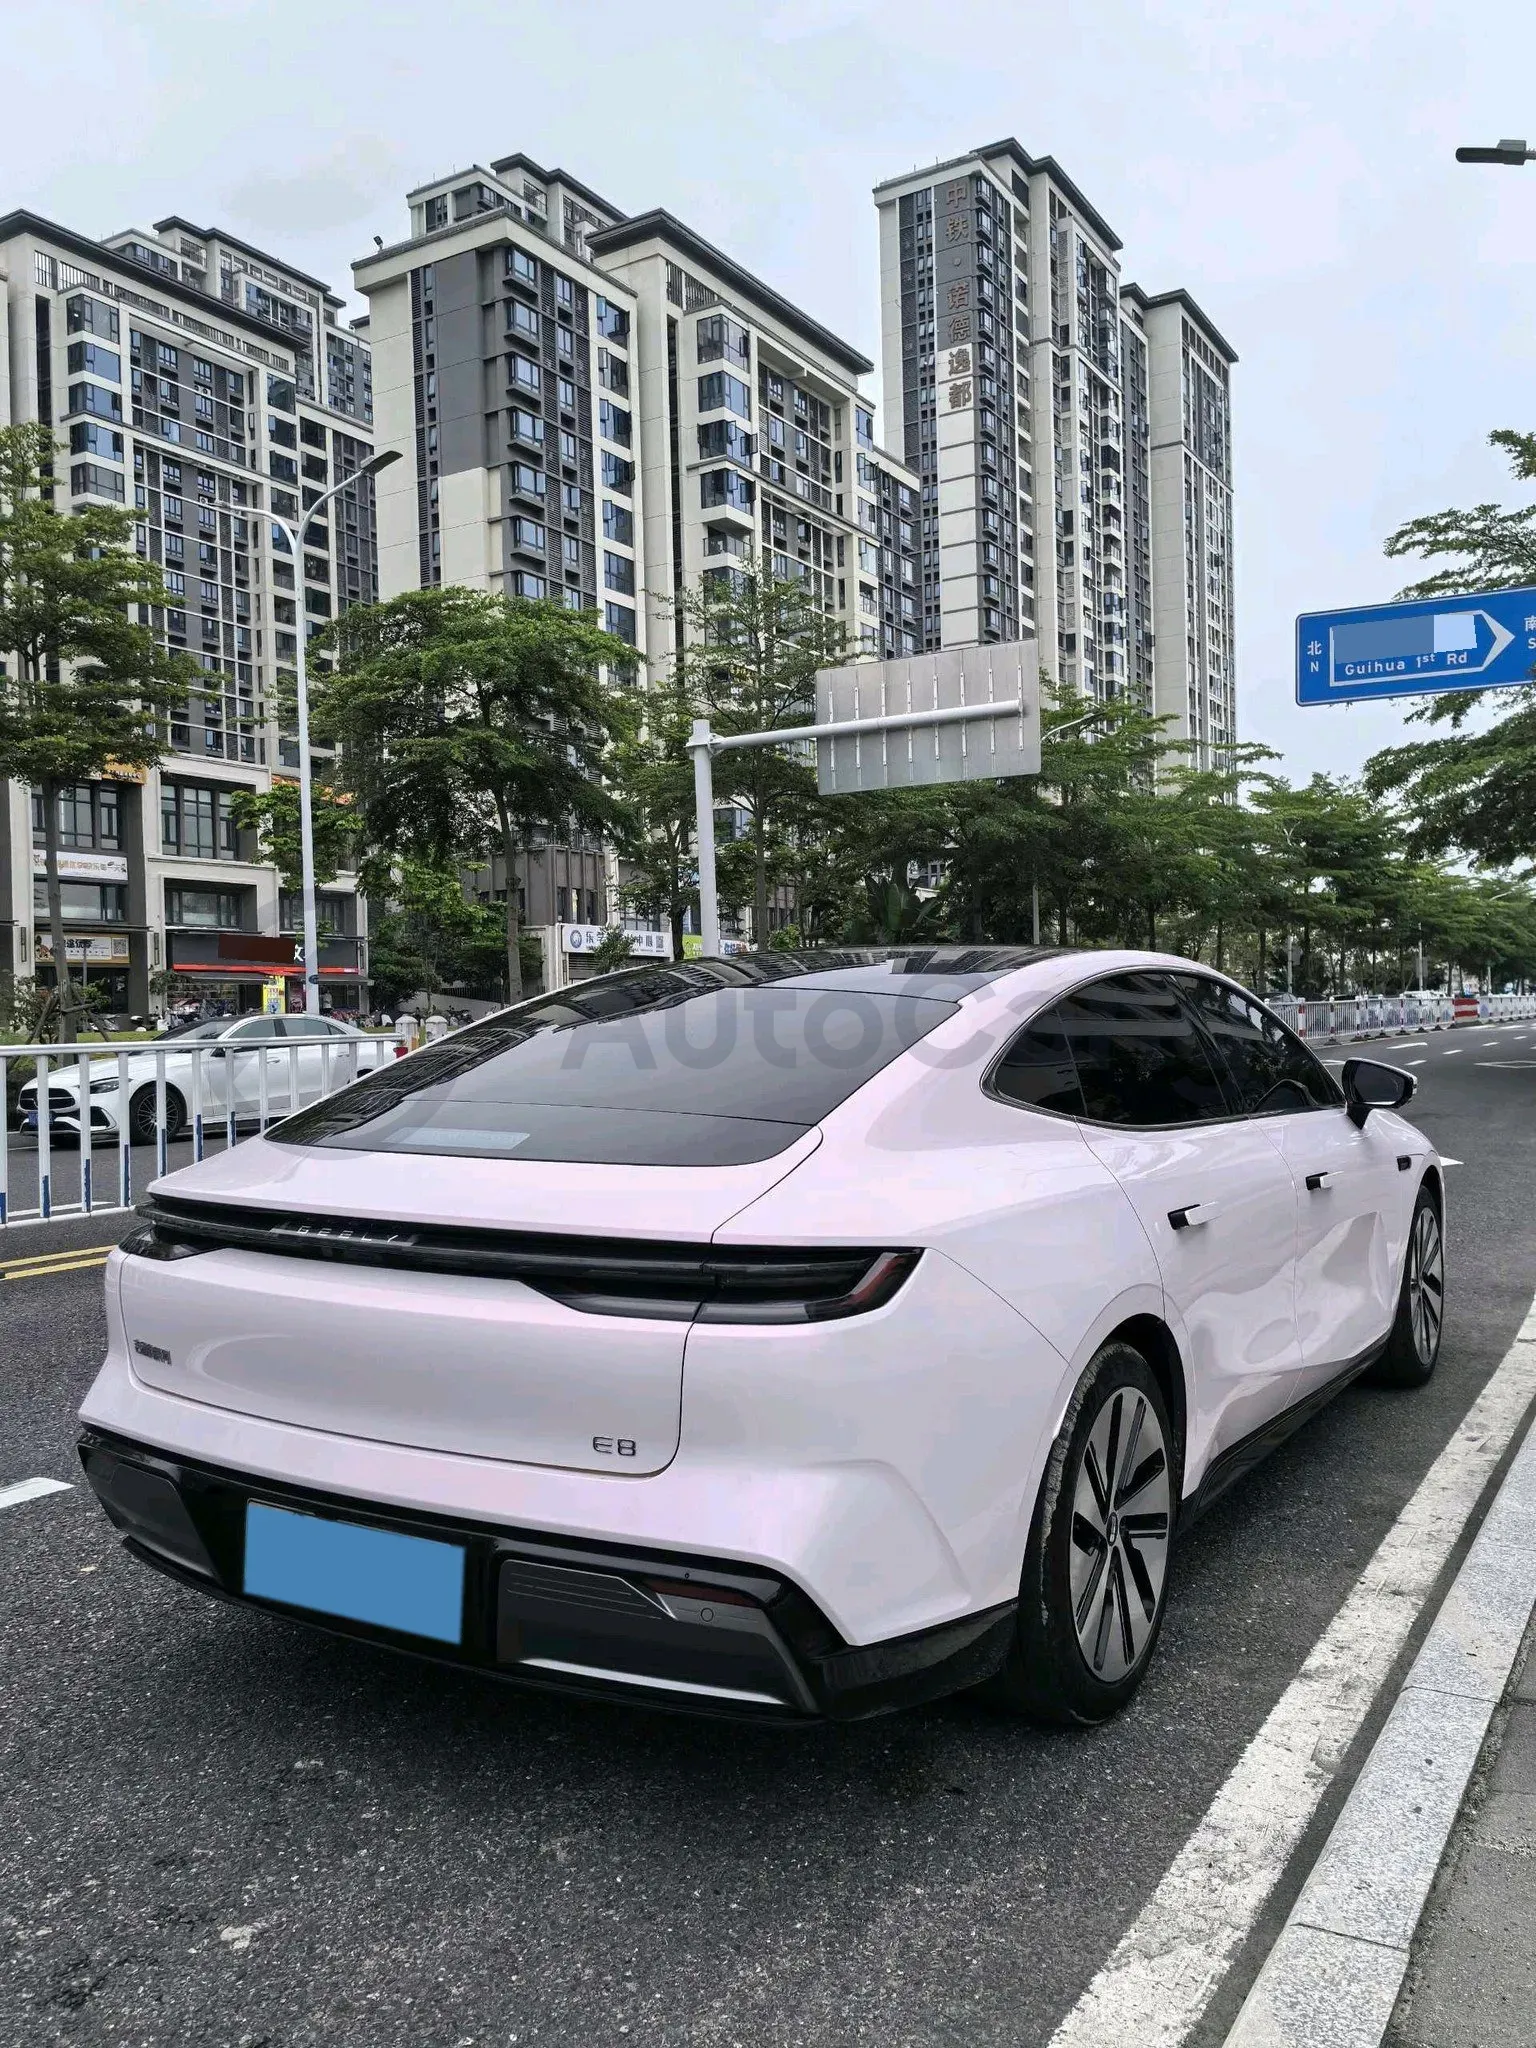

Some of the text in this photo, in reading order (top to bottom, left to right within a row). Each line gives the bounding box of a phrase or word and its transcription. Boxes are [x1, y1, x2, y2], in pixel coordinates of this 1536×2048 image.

[1307, 640, 1322, 656] 北
[1310, 661, 1319, 673] N
[1345, 652, 1468, 676] Guihua 1st Rd
[297, 1225, 399, 1244] GEELY
[592, 1436, 636, 1456] E8
